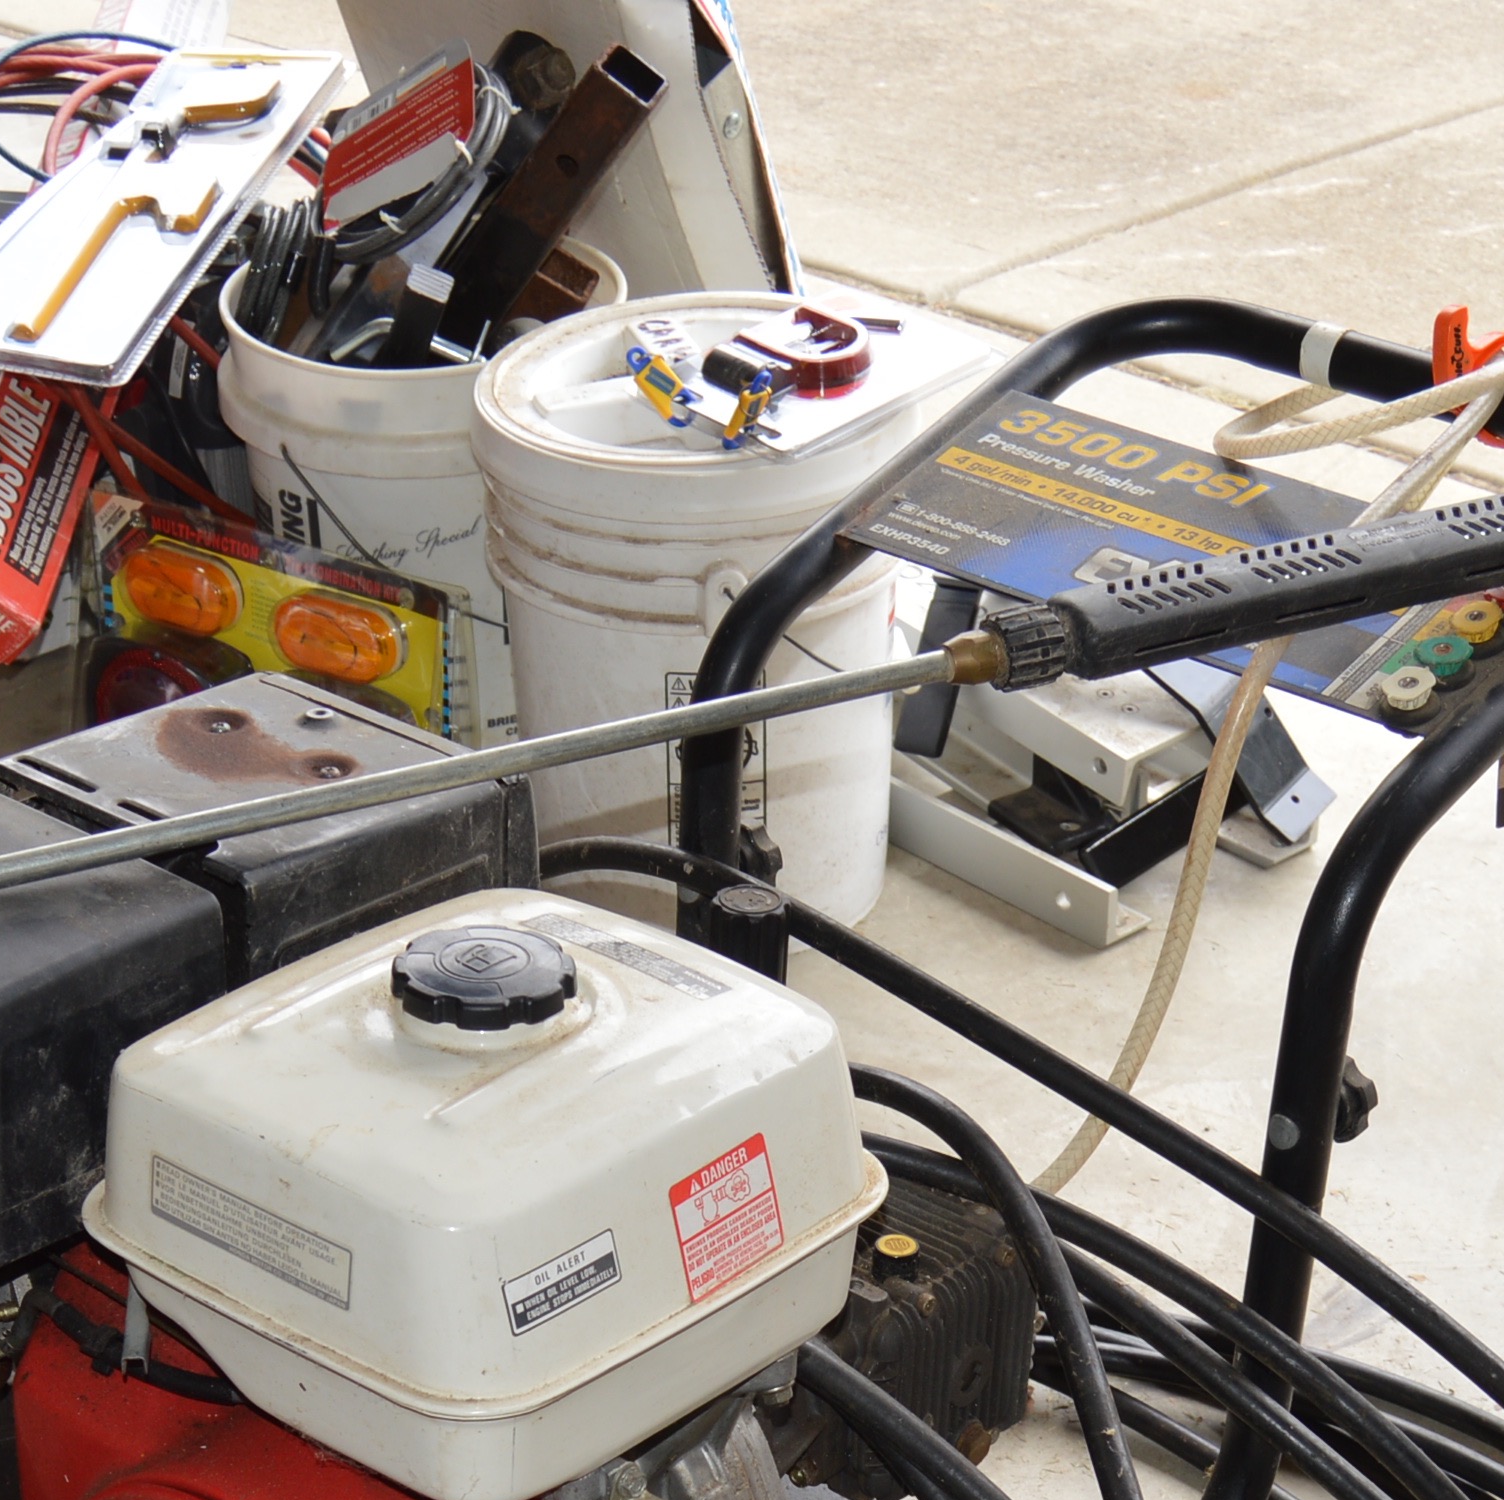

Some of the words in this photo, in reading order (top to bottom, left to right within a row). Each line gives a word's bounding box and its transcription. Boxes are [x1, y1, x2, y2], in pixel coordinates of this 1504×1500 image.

[975, 432, 1075, 472] Pressure
[1070, 463, 1159, 499] Washer
[992, 406, 1164, 475] 3500
[1152, 455, 1274, 510] PSI
[948, 453, 972, 467] 4
[964, 458, 1036, 488] gal/min
[1047, 485, 1121, 515] 14,000
[1168, 523, 1201, 542] 13
[1196, 532, 1230, 551] hp
[150, 514, 261, 562] MULTI-FUNCTION
[415, 514, 483, 558] Special
[869, 523, 950, 556] EXHP3540
[699, 1145, 749, 1188] DANGER
[219, 1191, 251, 1215] MANUAL
[533, 1268, 550, 1287] OIL
[555, 1249, 586, 1275] ALERT
[688, 1260, 695, 1272] DO
[695, 1254, 705, 1268] NOT
[704, 1240, 727, 1262] OPERATE
[523, 1291, 545, 1310] WHEN
[546, 1284, 558, 1298] OIL
[558, 1273, 579, 1292] LEVEL
[525, 1300, 551, 1322] ENGINE
[551, 1288, 573, 1308] STOPS
